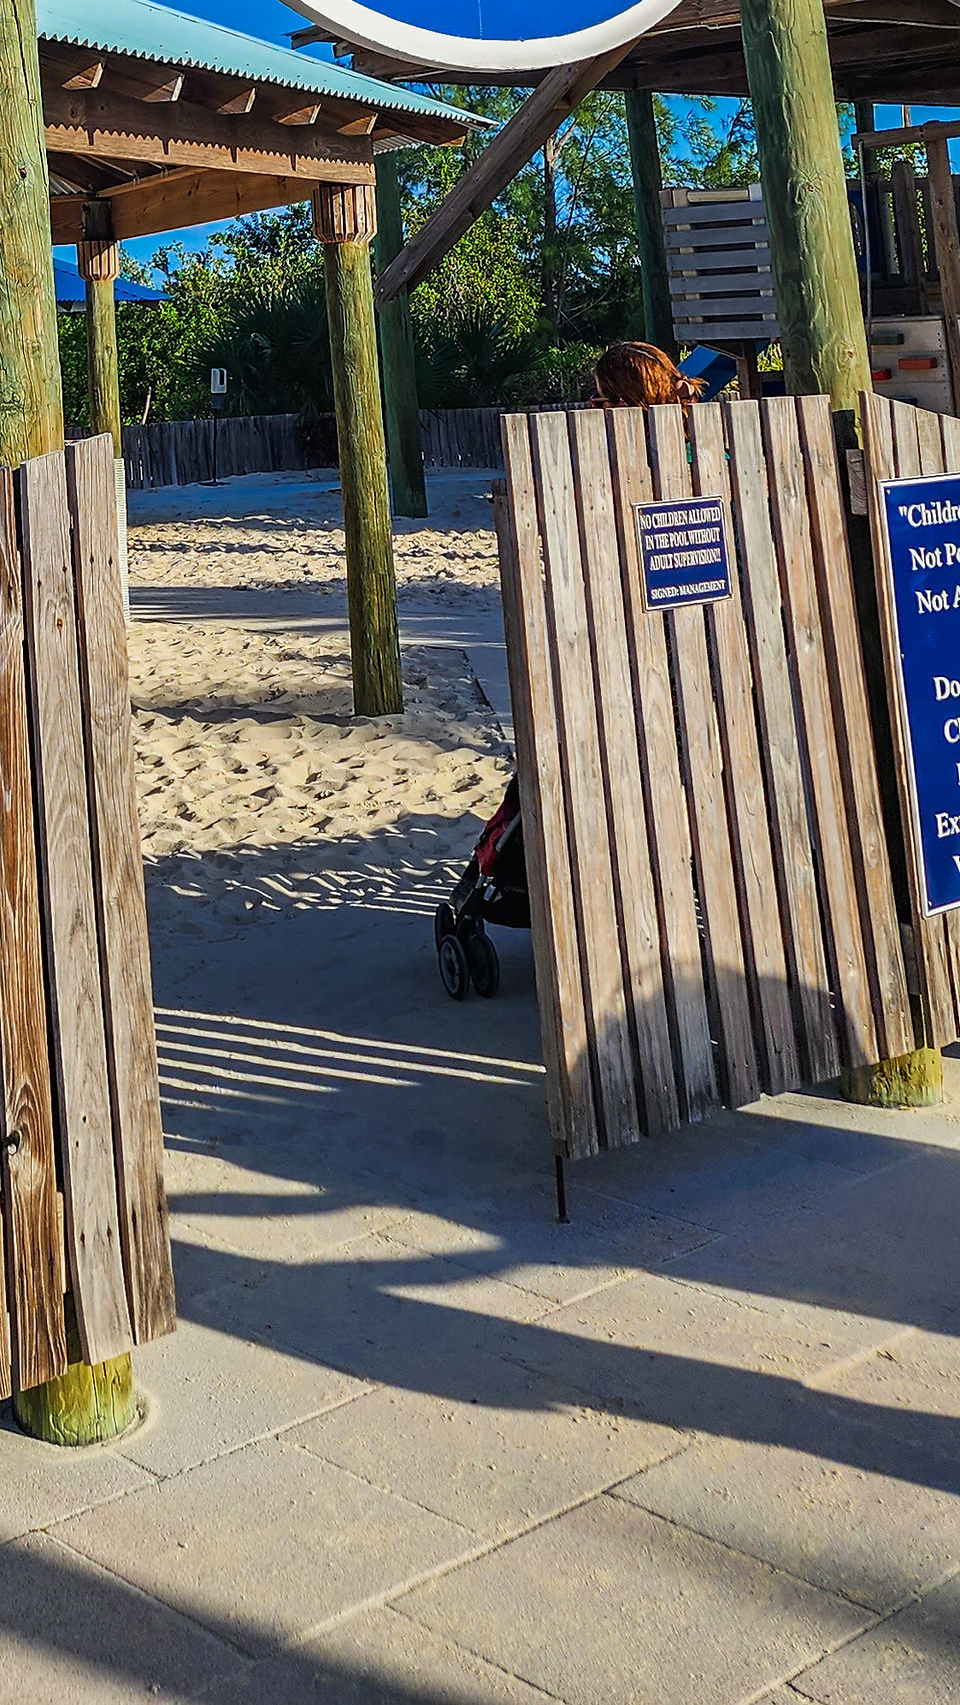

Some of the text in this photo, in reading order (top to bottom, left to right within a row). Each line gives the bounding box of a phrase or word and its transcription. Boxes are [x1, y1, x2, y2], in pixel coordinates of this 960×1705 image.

[639, 506, 721, 529] NO CHILDREN ALLOWED
[898, 499, 960, 528] "Childr
[645, 527, 720, 550] IN THE POOL WITHOUT
[649, 553, 674, 571] ADULT
[908, 546, 943, 571] Not
[651, 579, 726, 600] SIGNED: MANAGEMENT
[915, 589, 949, 614] Not
